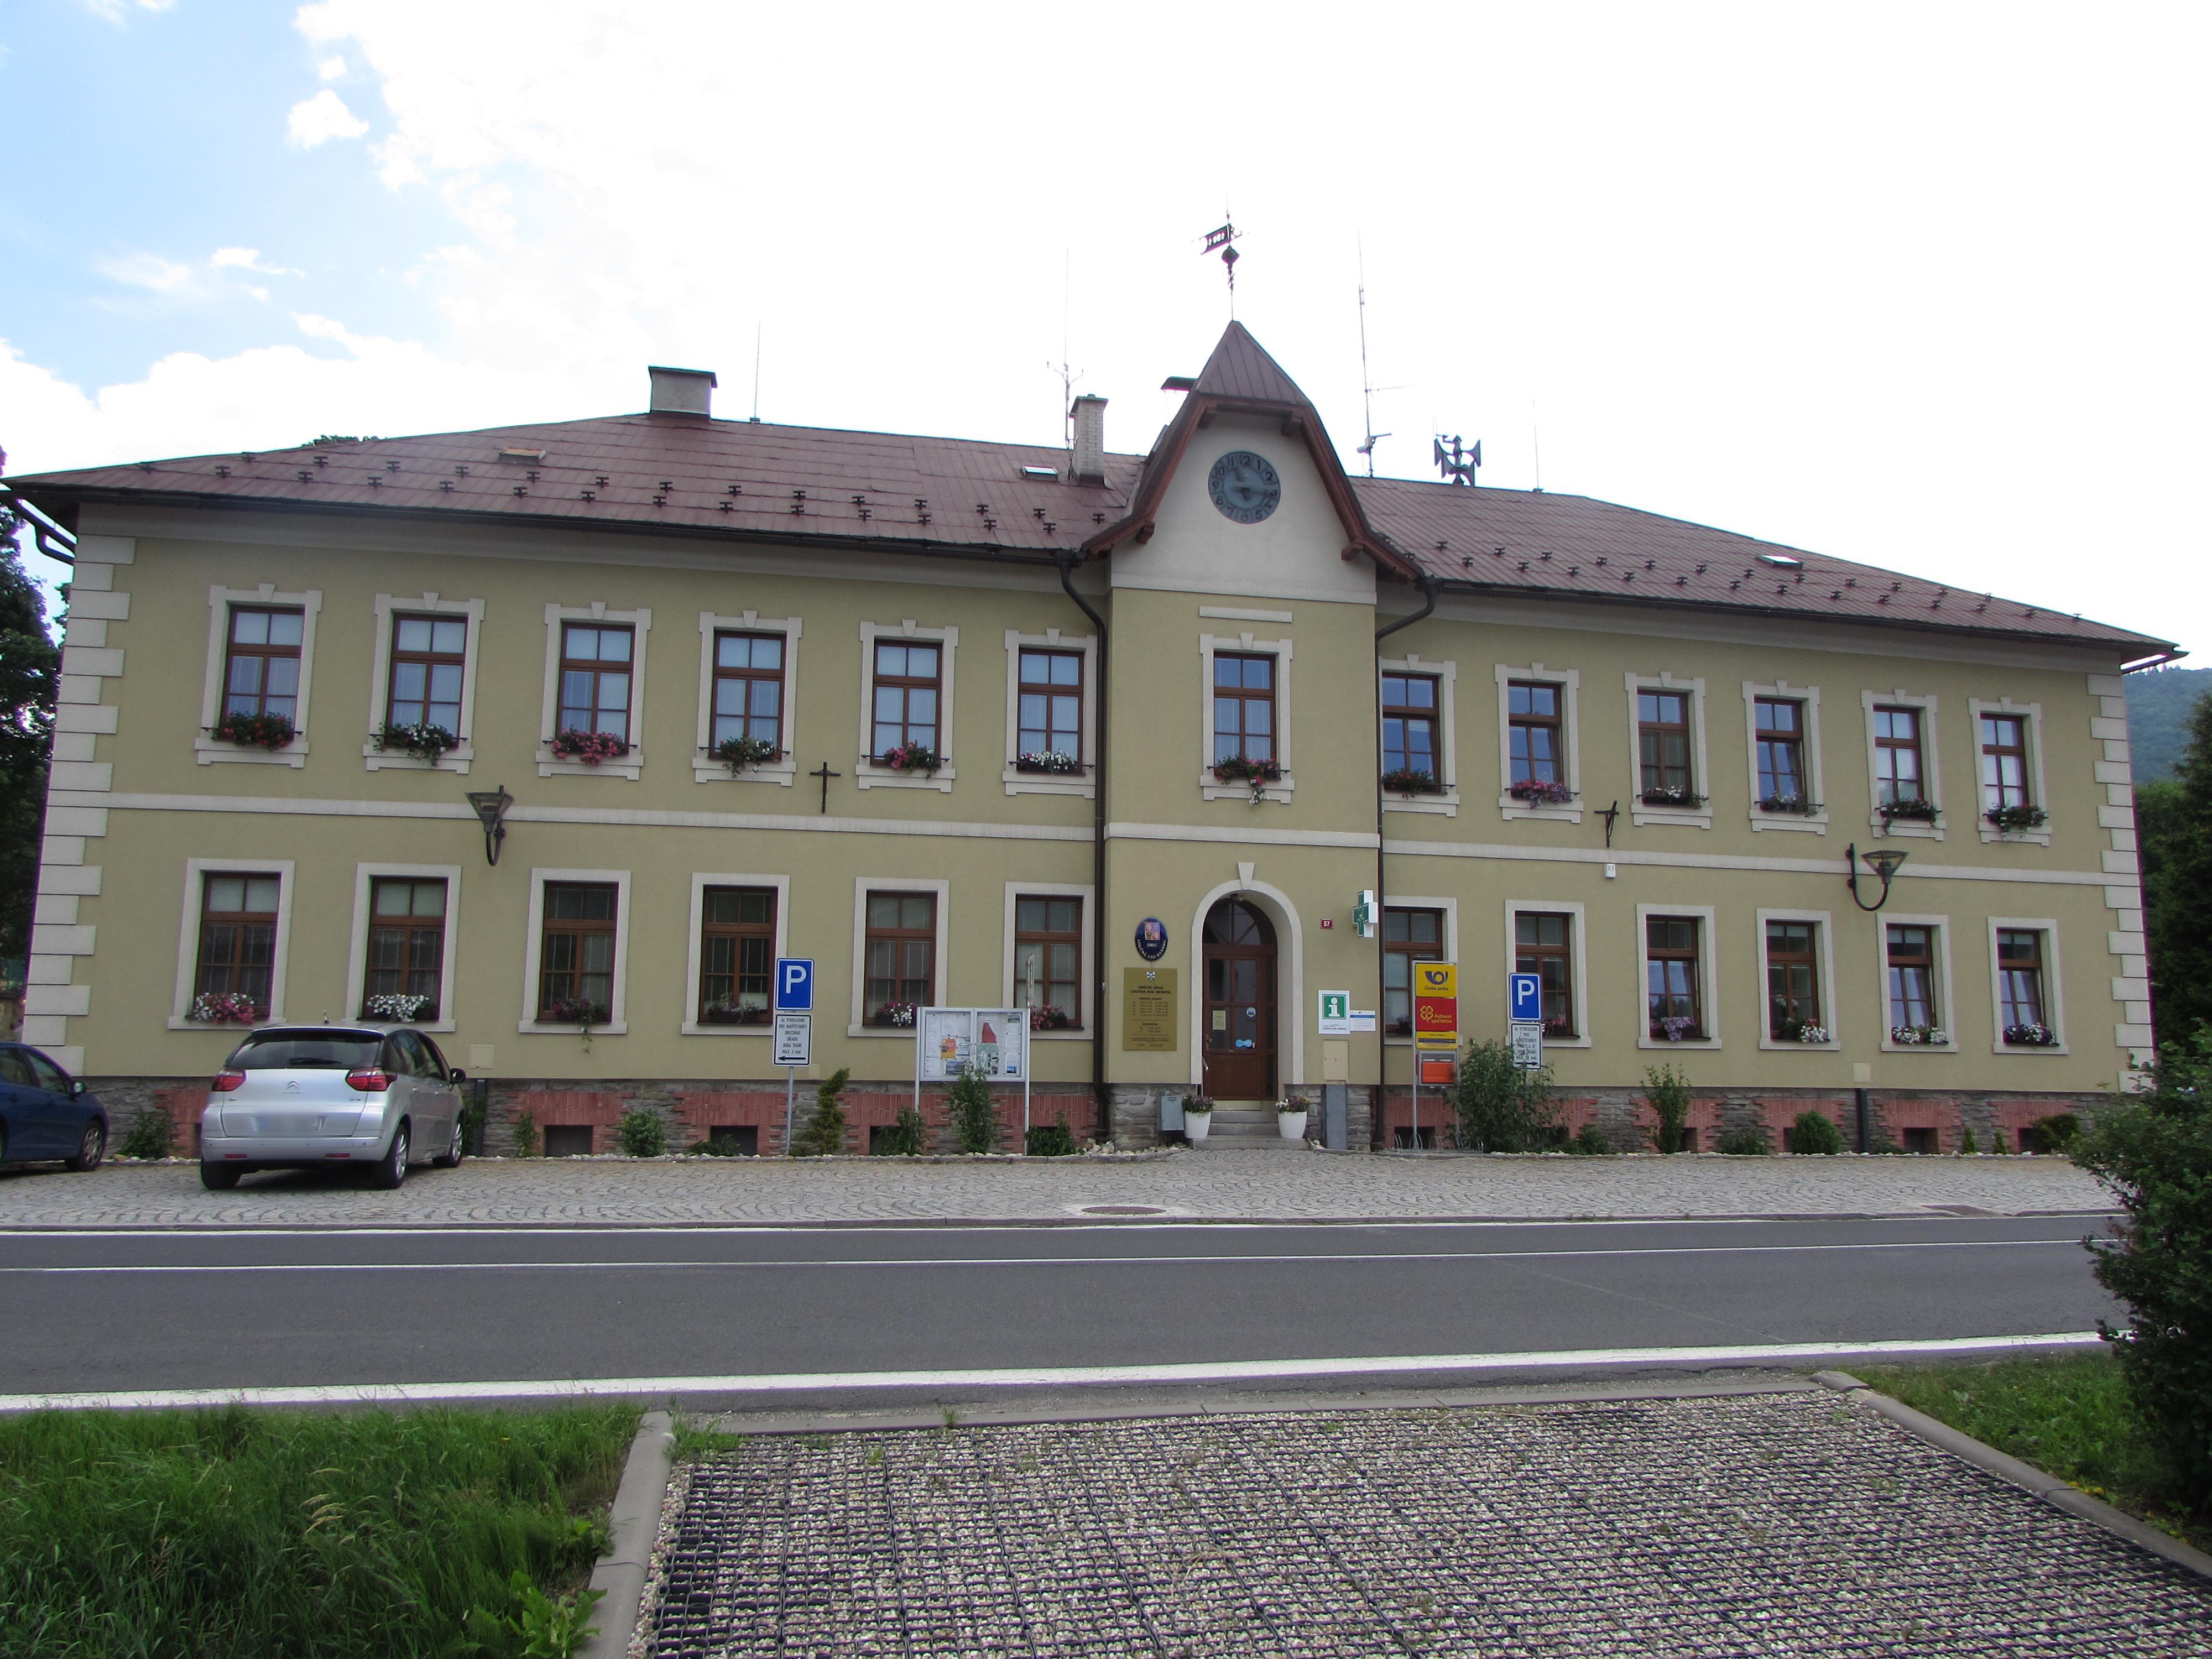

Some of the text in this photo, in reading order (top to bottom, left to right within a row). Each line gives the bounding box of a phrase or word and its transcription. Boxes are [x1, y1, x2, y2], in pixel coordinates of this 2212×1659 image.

[1227, 456, 1234, 467] 11
[1239, 455, 1250, 468] 12
[1257, 460, 1261, 470] 1
[1215, 467, 1225, 476] 10
[1265, 471, 1272, 481] 2
[1212, 481, 1219, 491] 9
[1216, 495, 1224, 505] 8
[1227, 506, 1234, 515] 7
[1240, 510, 1249, 521] 6
[1255, 509, 1262, 519] 5
[786, 965, 806, 993] P
[1517, 979, 1534, 1005] P
